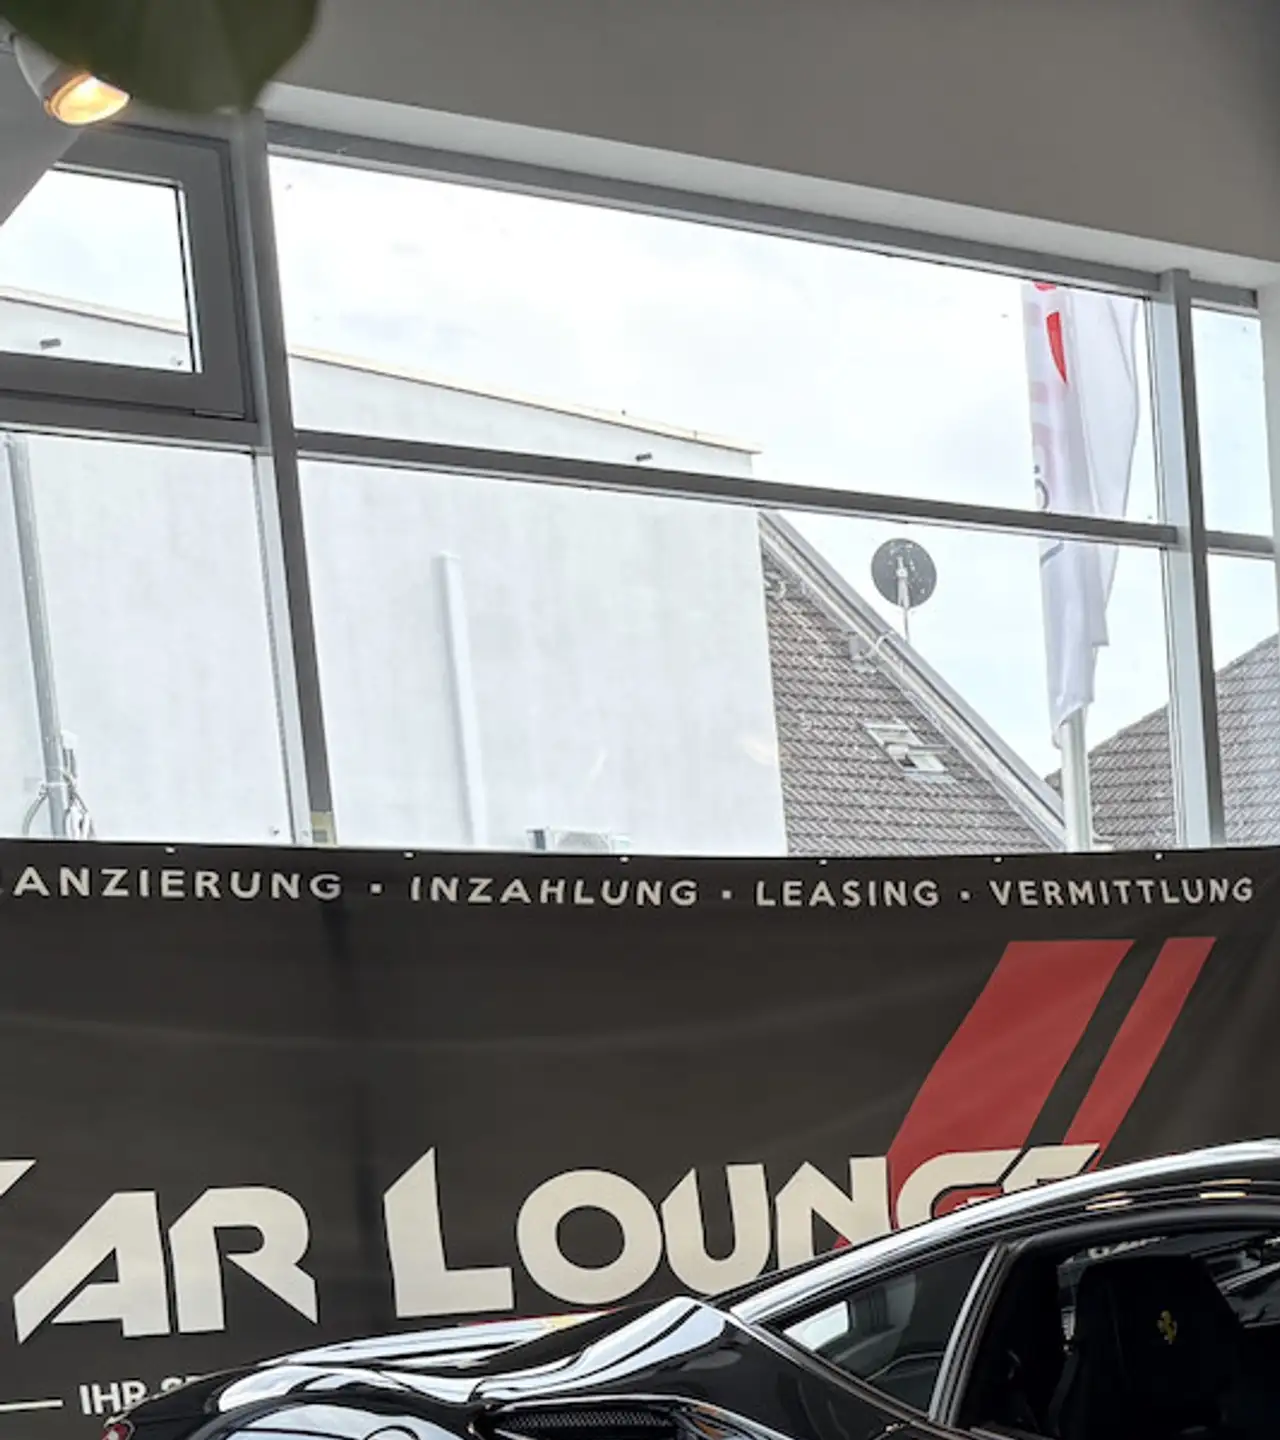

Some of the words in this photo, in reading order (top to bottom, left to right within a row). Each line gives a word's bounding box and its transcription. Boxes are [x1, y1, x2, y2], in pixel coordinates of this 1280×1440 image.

[0, 866, 343, 900] ANZIERUNG
[411, 876, 697, 907] INZAHLUNG
[756, 880, 940, 907] LEASING
[990, 877, 1254, 906] VERMITTLUNG
[0, 1159, 318, 1344] AR
